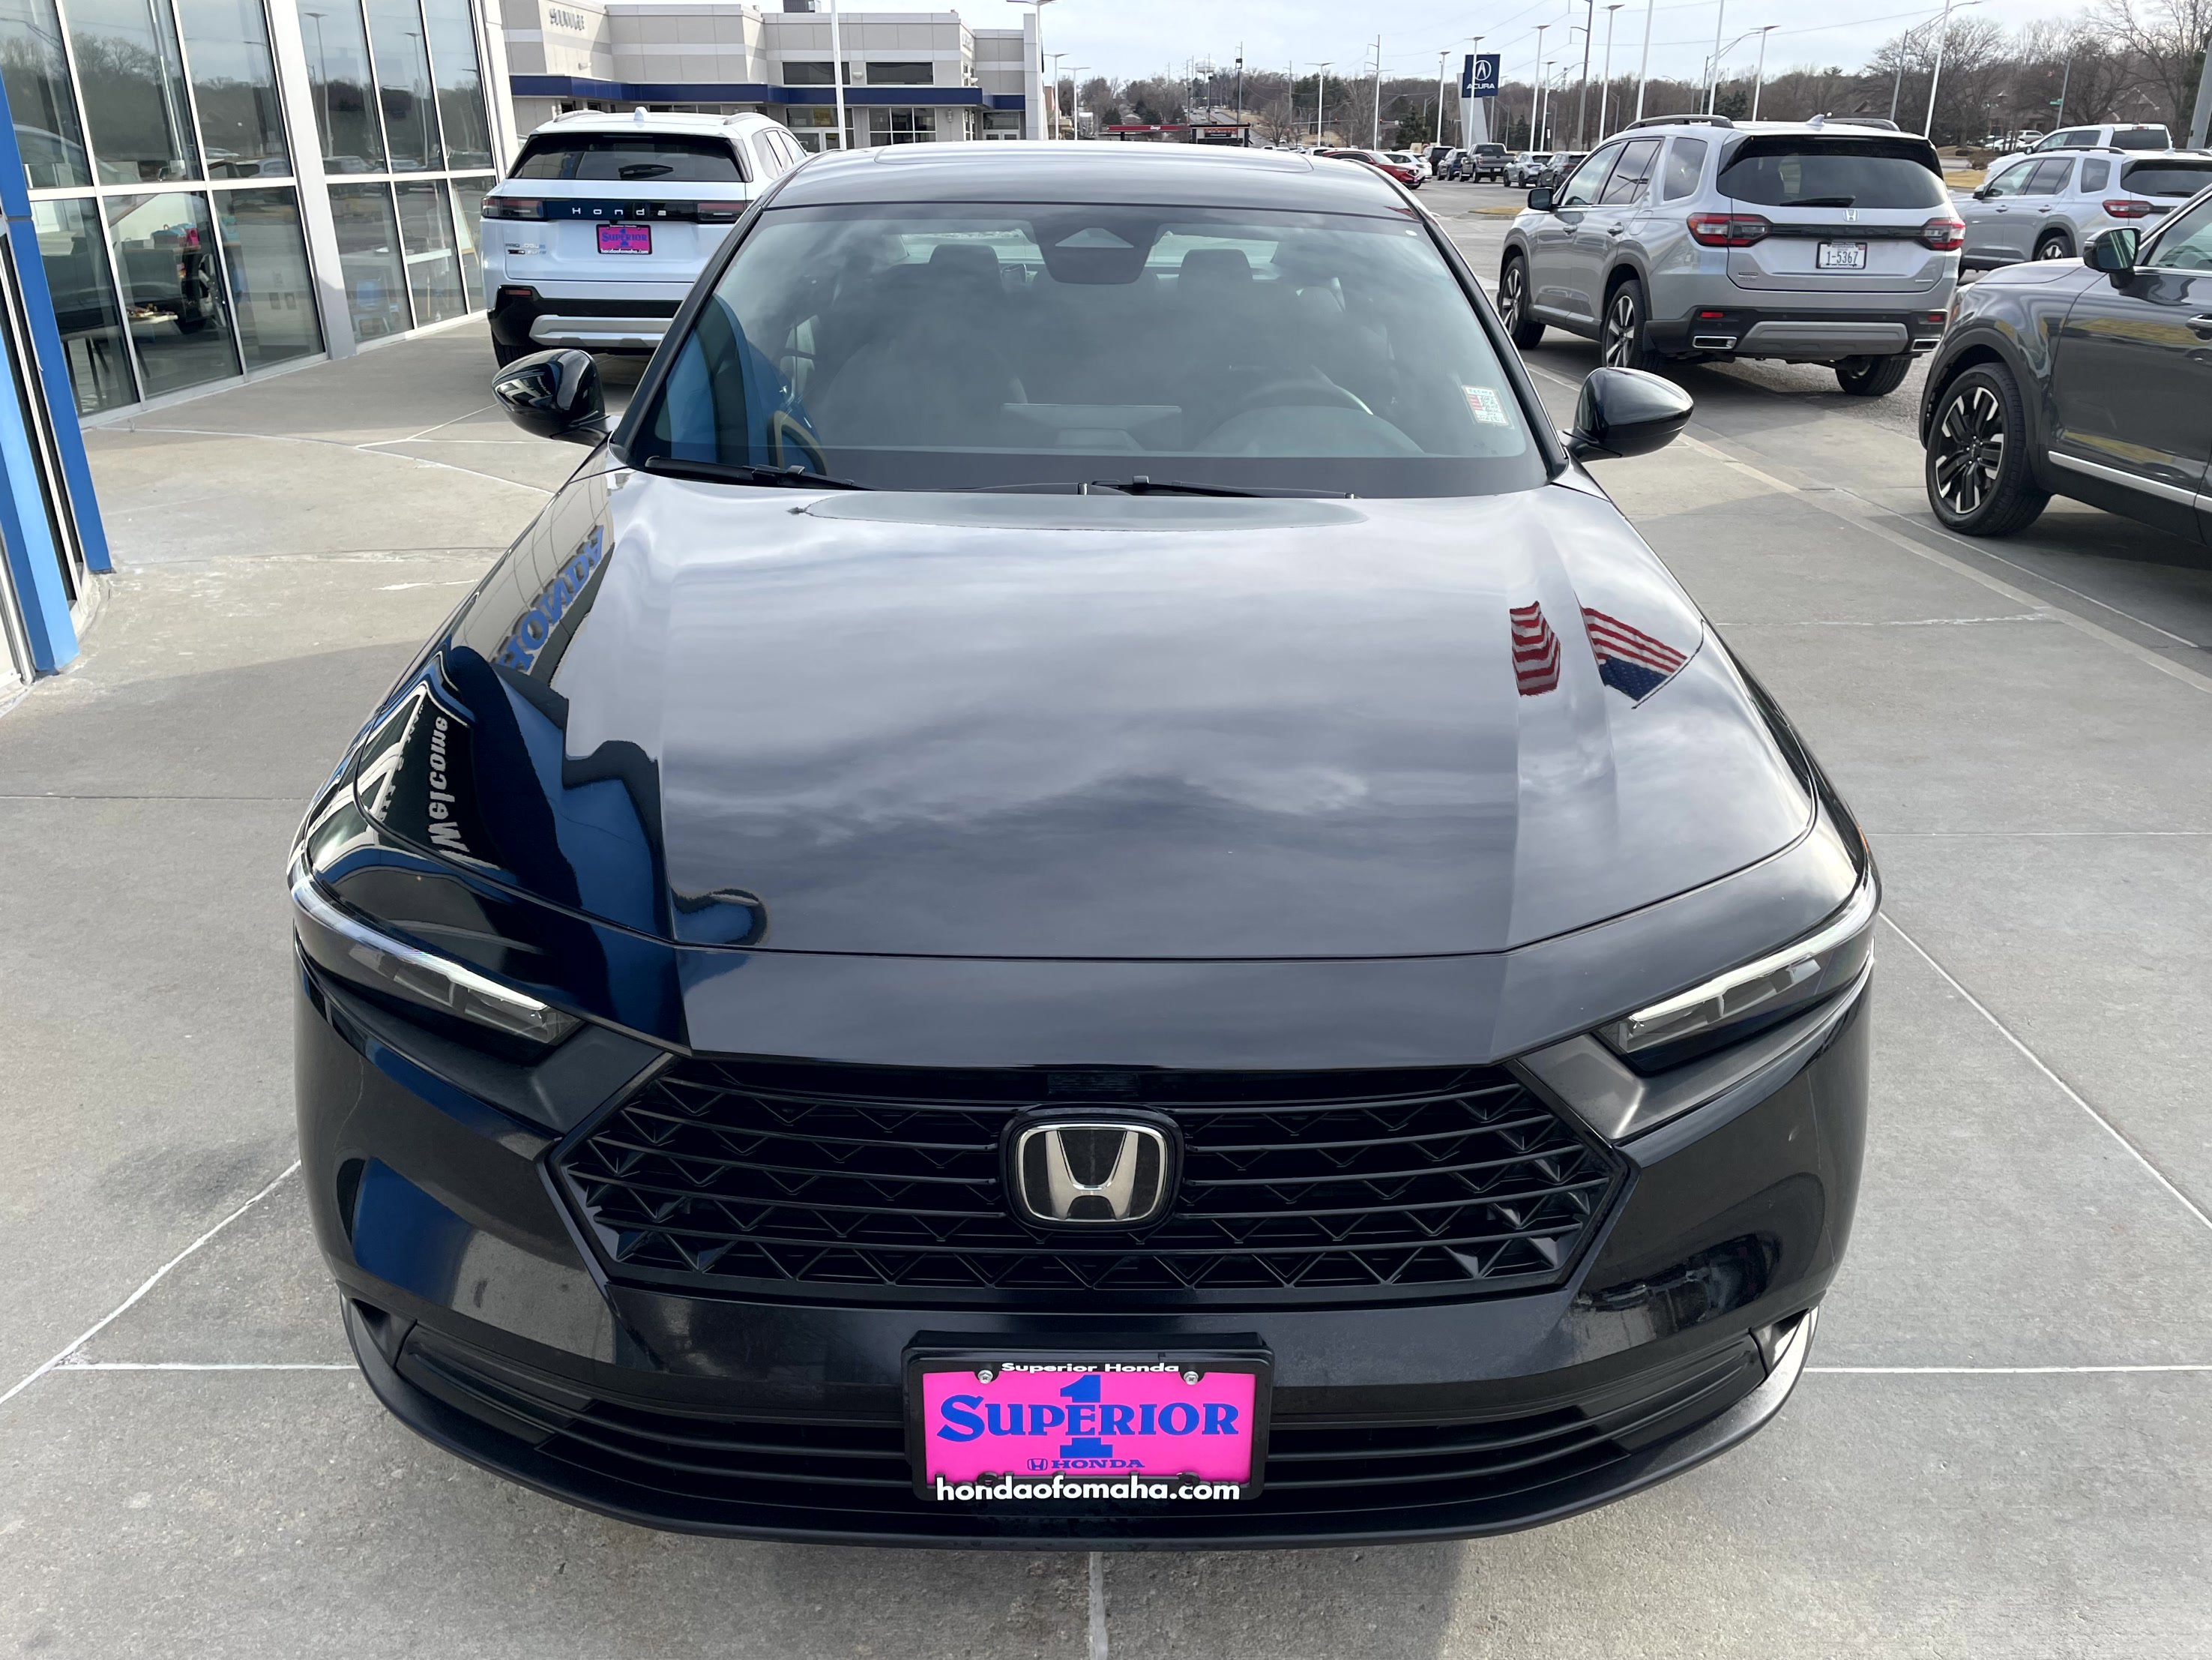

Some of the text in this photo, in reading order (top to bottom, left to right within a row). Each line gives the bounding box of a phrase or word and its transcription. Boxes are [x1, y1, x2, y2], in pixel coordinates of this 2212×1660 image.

[1827, 251, 1858, 263] 1-5367
[1001, 1362, 1179, 1373] Superior Honda
[937, 1395, 1239, 1442] SUPERIOR
[1051, 1459, 1145, 1469] HONDA
[936, 1476, 1240, 1500] hondaofomaha.com
